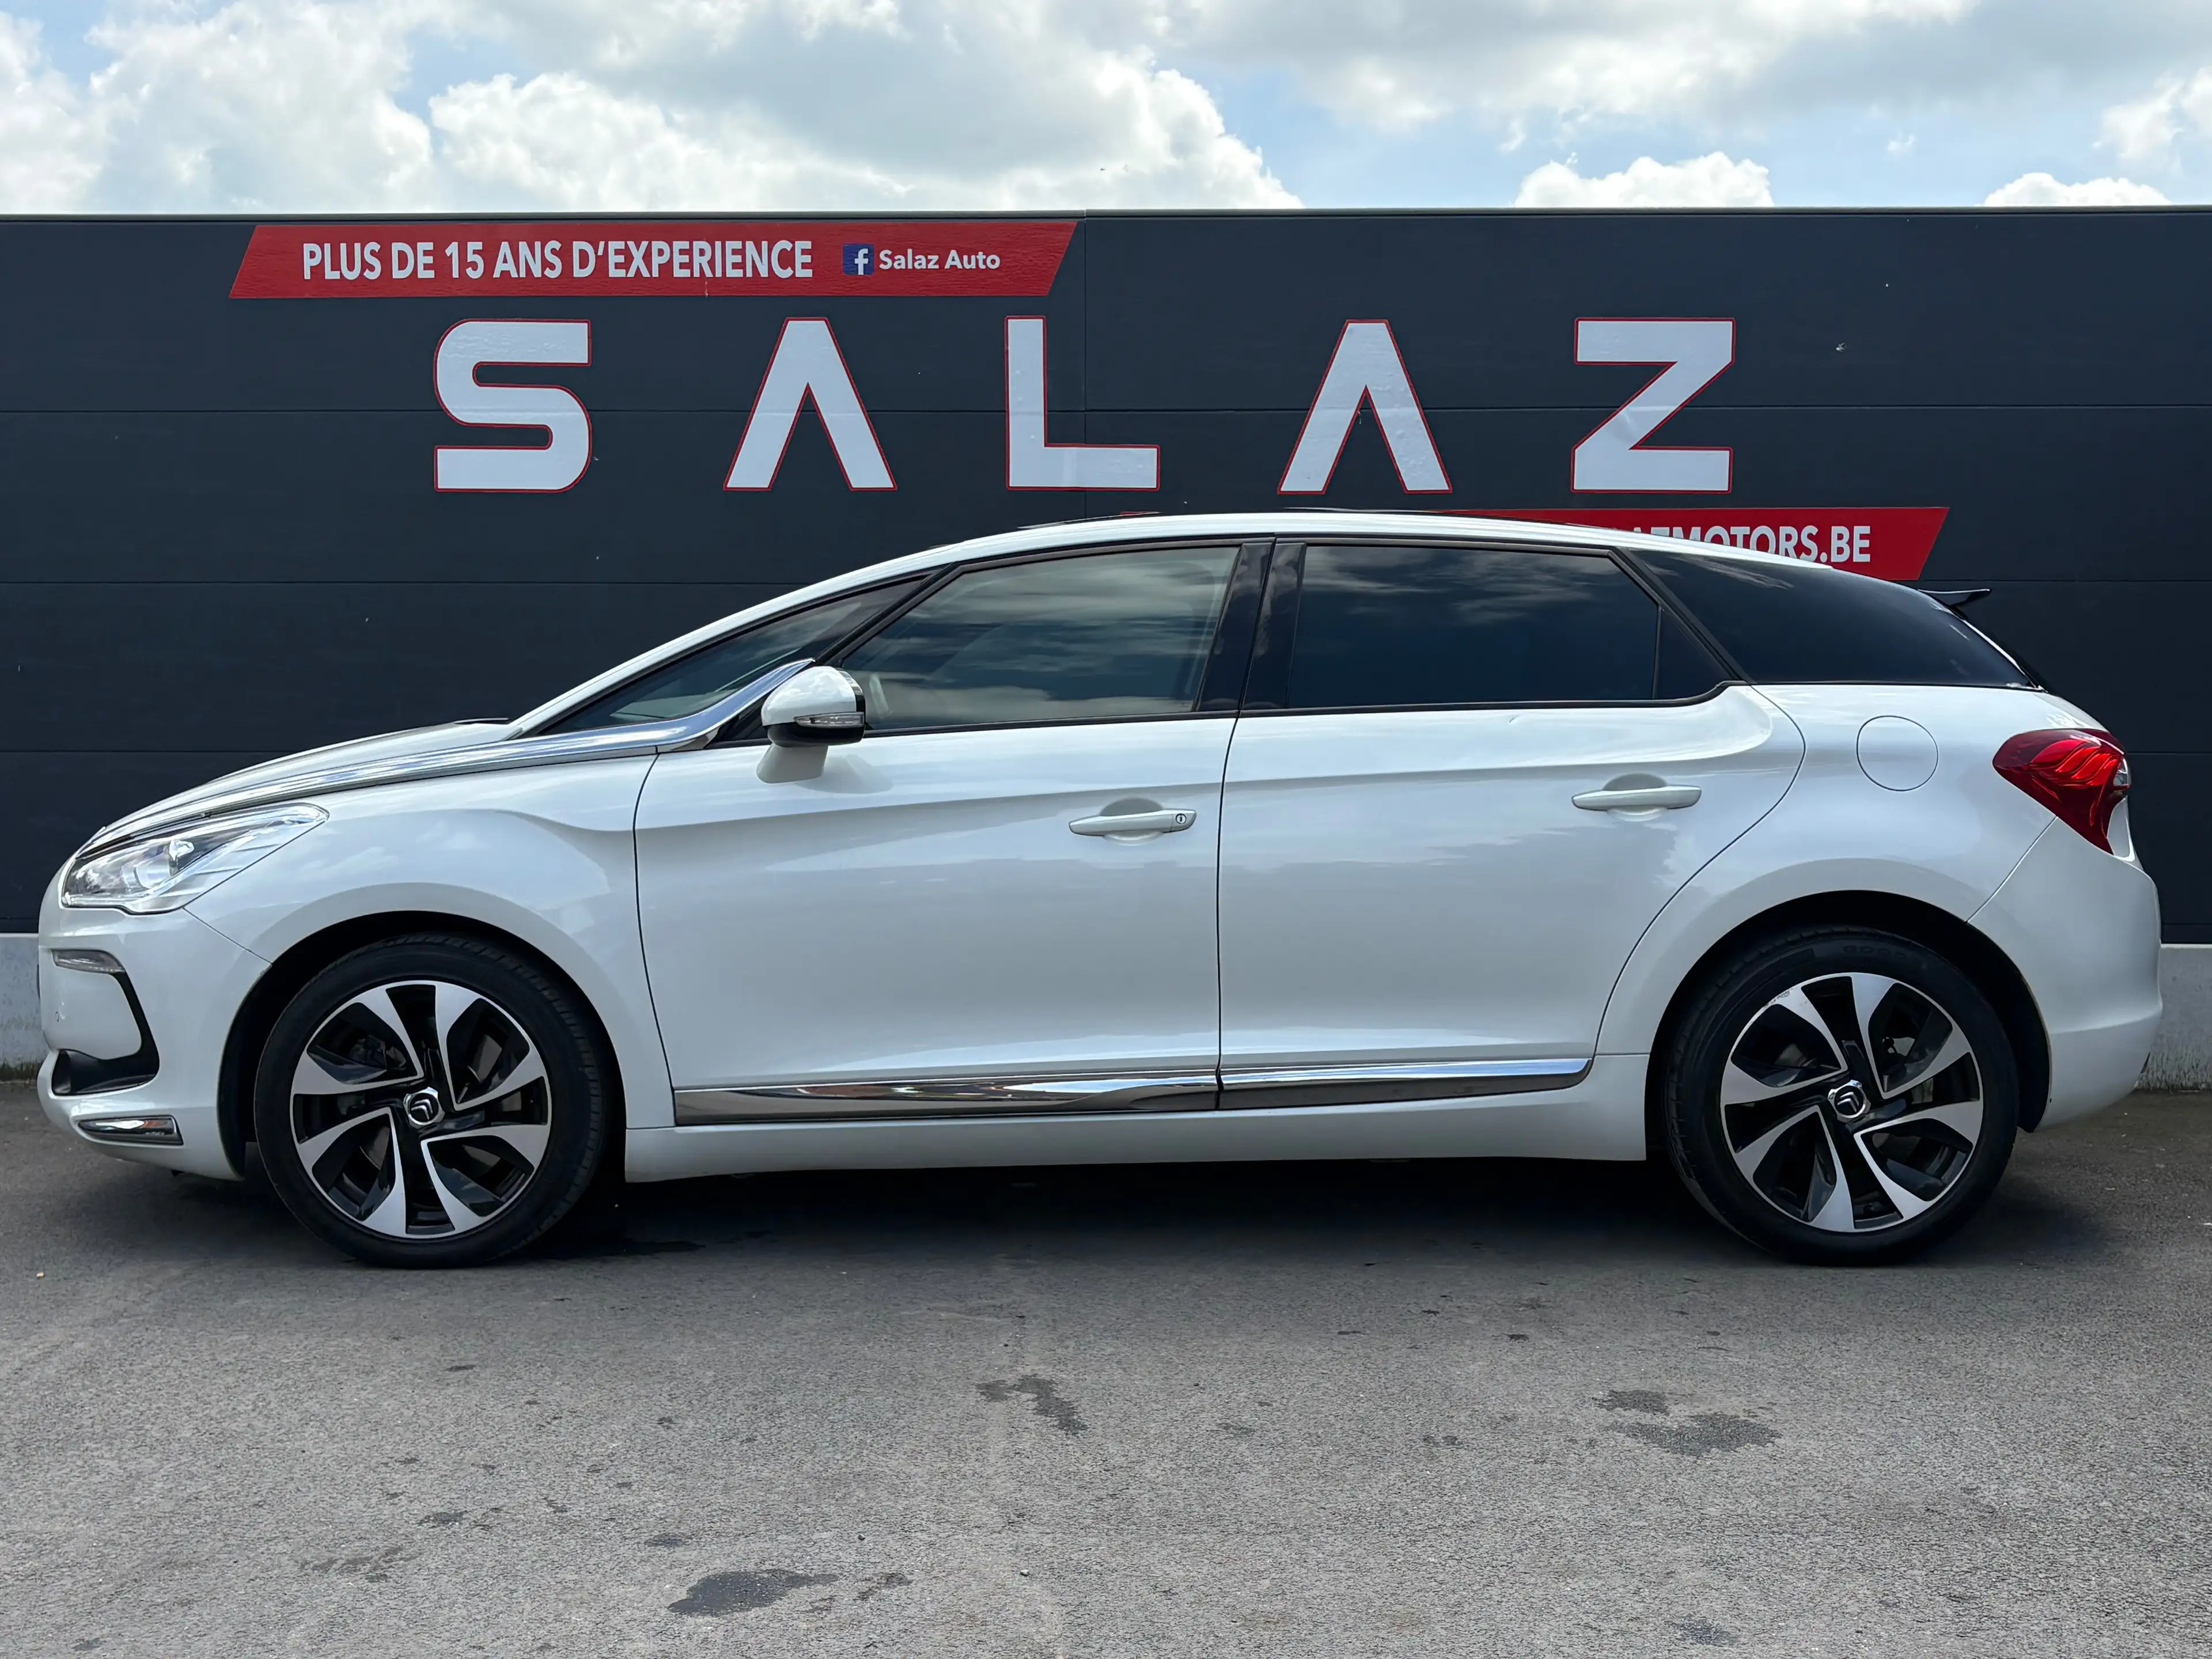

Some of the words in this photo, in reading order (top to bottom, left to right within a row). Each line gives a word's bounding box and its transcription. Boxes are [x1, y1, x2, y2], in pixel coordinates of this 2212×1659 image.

[303, 241, 381, 280] PLUS
[392, 242, 435, 279] DE
[445, 241, 484, 279] 15
[493, 240, 562, 279] ANS
[573, 240, 813, 279] D'EXPERIENCE
[879, 248, 940, 270] Salaz
[945, 249, 1001, 270] Auto
[434, 316, 1736, 494] SALAZ
